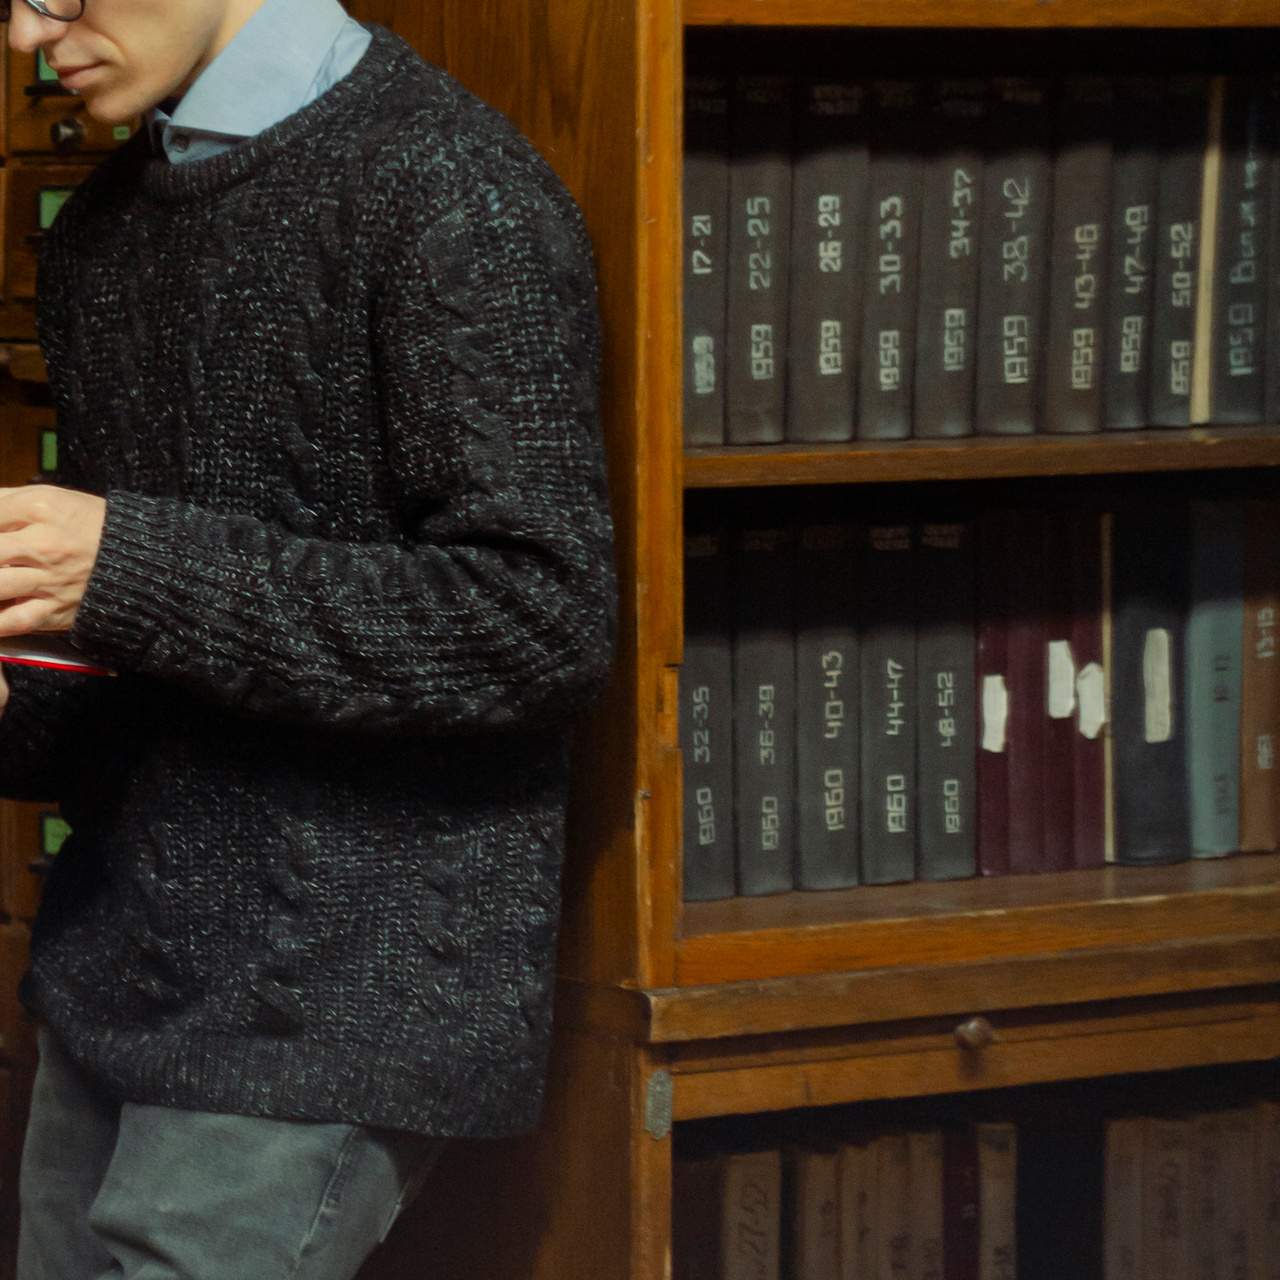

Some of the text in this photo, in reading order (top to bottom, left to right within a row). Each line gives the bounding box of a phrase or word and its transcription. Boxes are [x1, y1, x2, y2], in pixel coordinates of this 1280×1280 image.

[690, 214, 712, 276] 17-21
[746, 195, 772, 291] 22-25
[818, 194, 842, 375] 1959 26-29
[878, 195, 903, 392] 1959 30-33
[943, 168, 973, 373] 1959 34-37
[1001, 177, 1030, 385] 1959 38-42
[1071, 223, 1099, 390] 1959 43-46
[1120, 204, 1150, 373] 1959 47-49
[1170, 222, 1193, 308] 50-52
[692, 684, 717, 846] 1960 32-35
[758, 683, 779, 851] 1960 36-39
[821, 649, 846, 832] 1960 40-43
[885, 657, 908, 834] 1960 44-47
[936, 671, 963, 835] 1960 48-52
